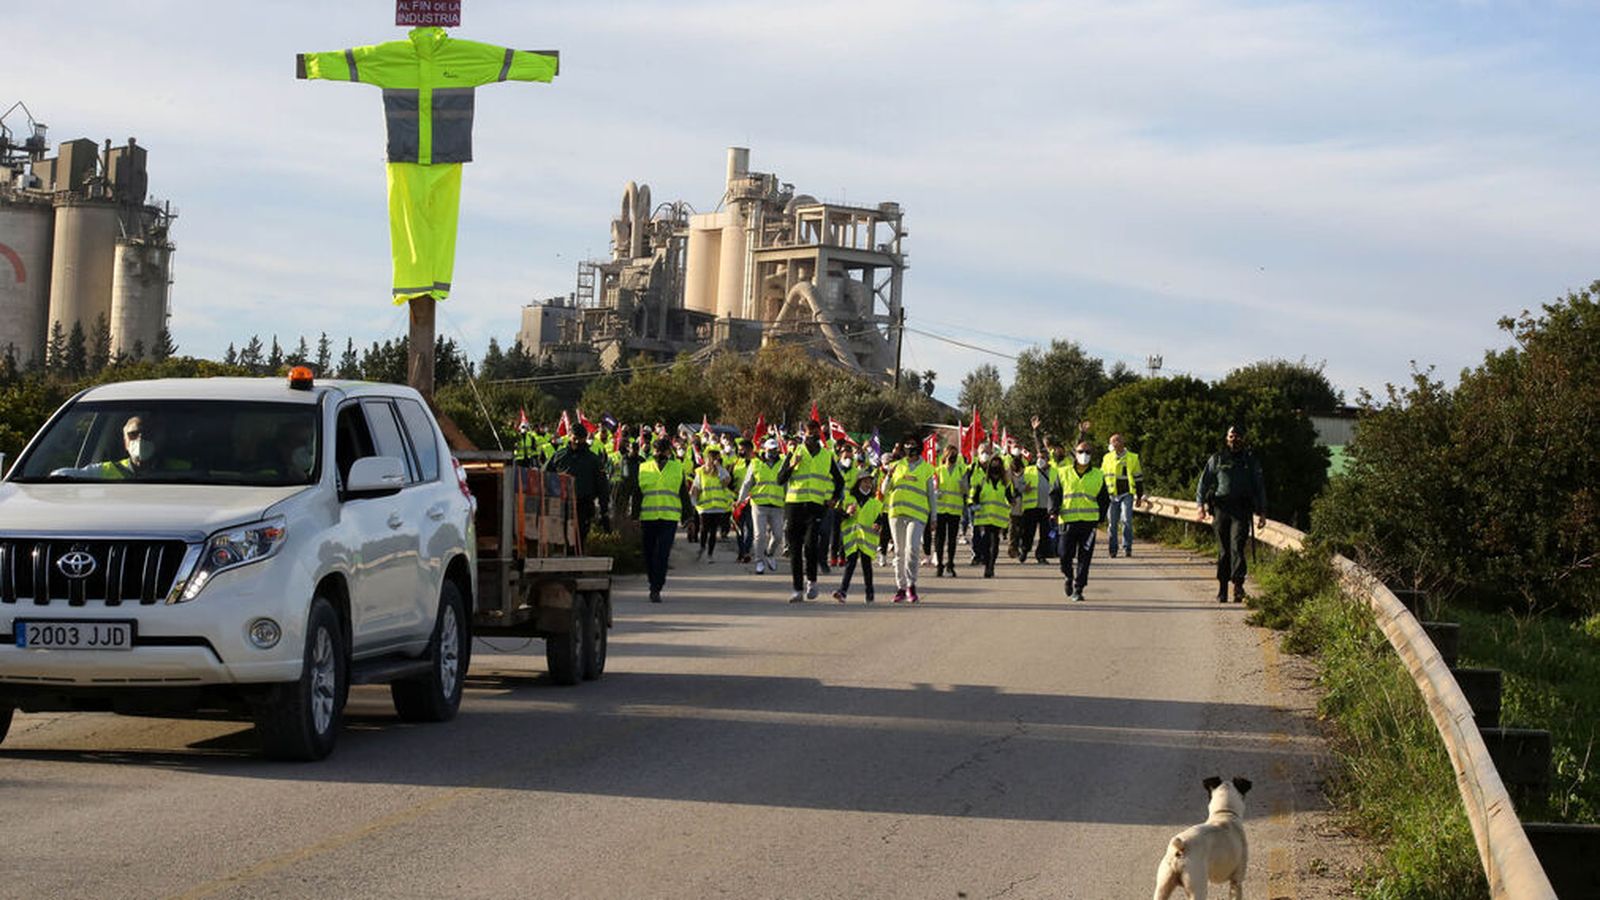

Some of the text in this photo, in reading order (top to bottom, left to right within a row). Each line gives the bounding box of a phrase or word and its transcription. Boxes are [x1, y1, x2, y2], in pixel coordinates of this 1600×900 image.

[398, 1, 460, 11] AL FIN DE LA
[397, 12, 460, 23] INDUSTRIA
[29, 626, 125, 646] 2003 JJD
